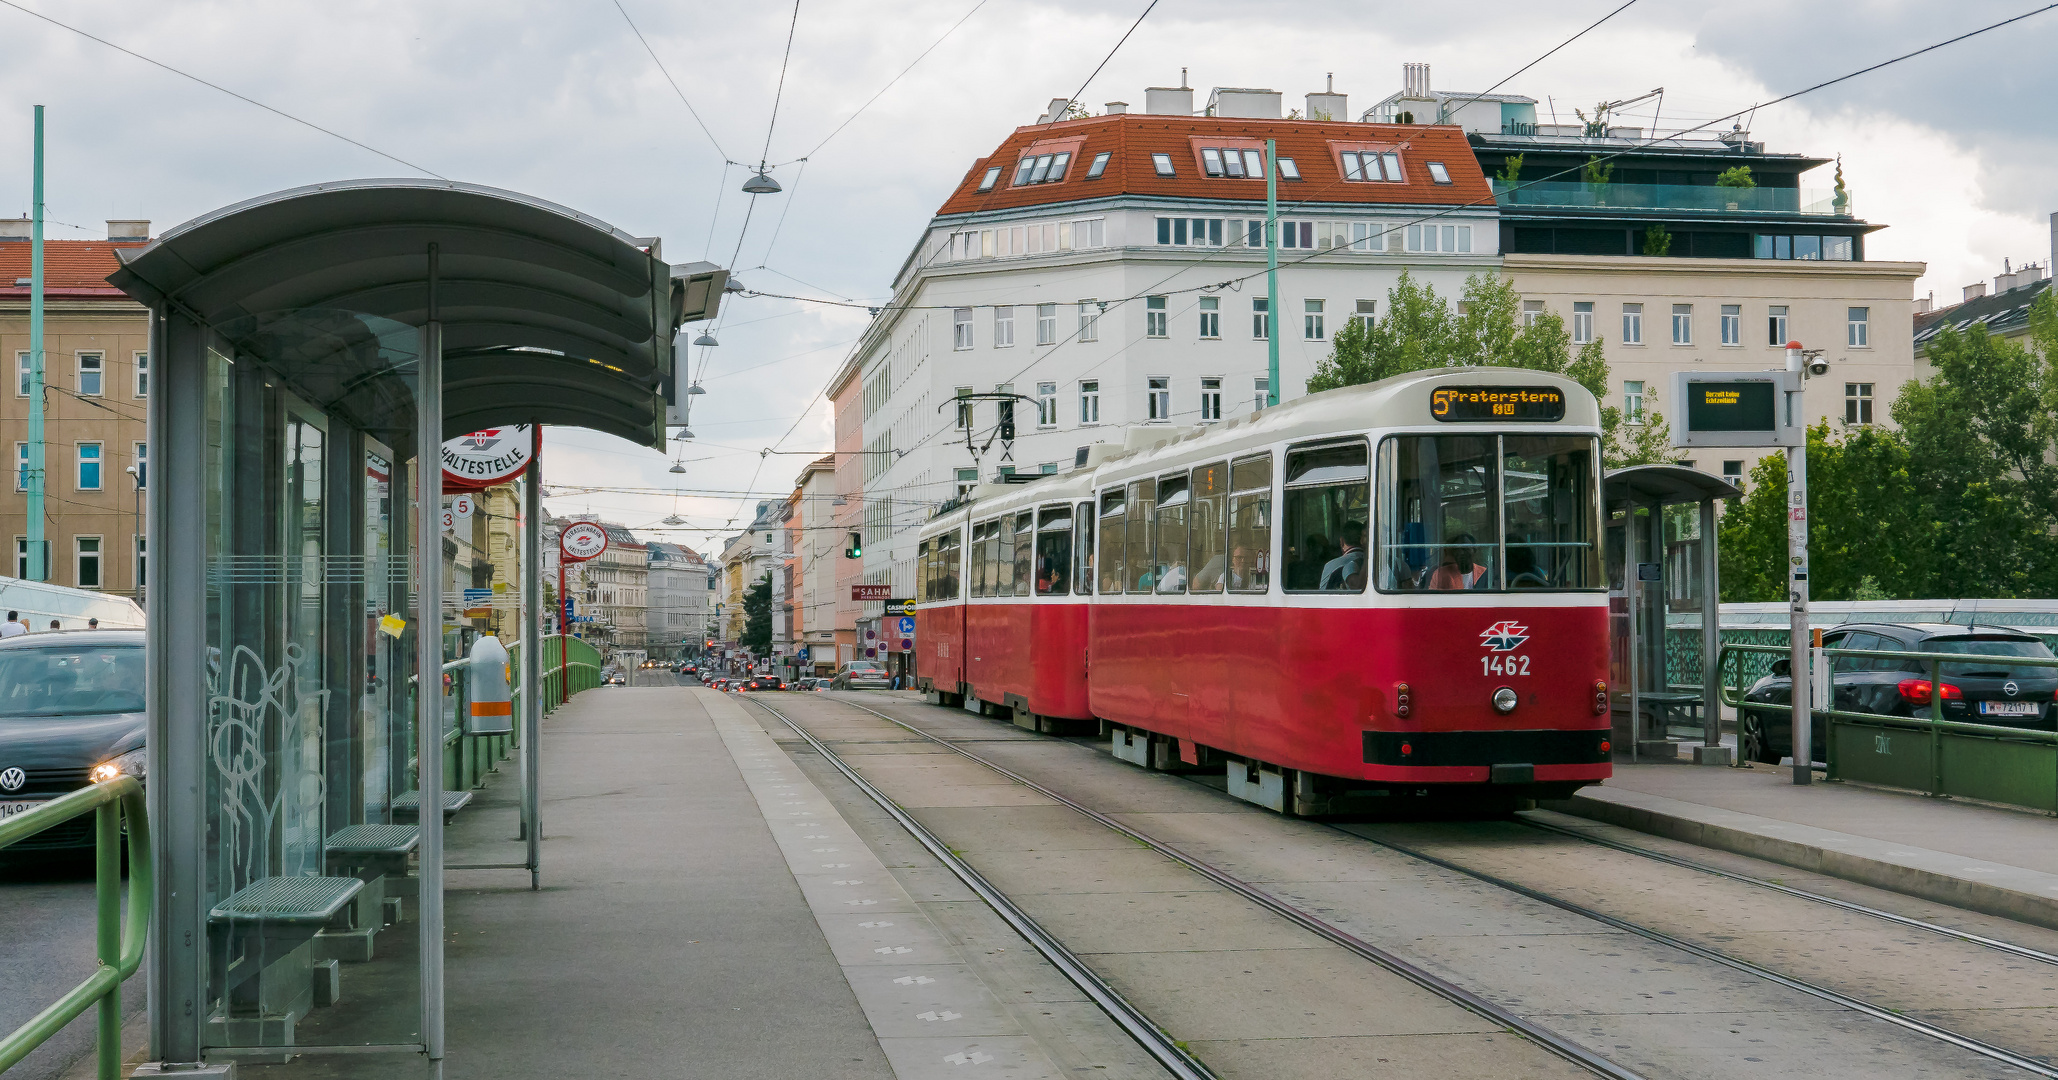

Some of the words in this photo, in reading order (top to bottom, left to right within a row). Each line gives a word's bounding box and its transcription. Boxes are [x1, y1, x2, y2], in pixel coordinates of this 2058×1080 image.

[1433, 390, 1449, 415] 5
[1449, 390, 1559, 403] Praterstern
[441, 446, 524, 475] HALTESTELLE
[458, 500, 468, 513] 5
[565, 526, 602, 540] STRASSENBAHN
[567, 543, 601, 556] HALTESTELLE
[861, 588, 890, 596] SAHM
[1480, 655, 1531, 677] 1462
[1988, 703, 1995, 712] W
[2001, 702, 2026, 712] 72117
[2029, 703, 2034, 712] T
